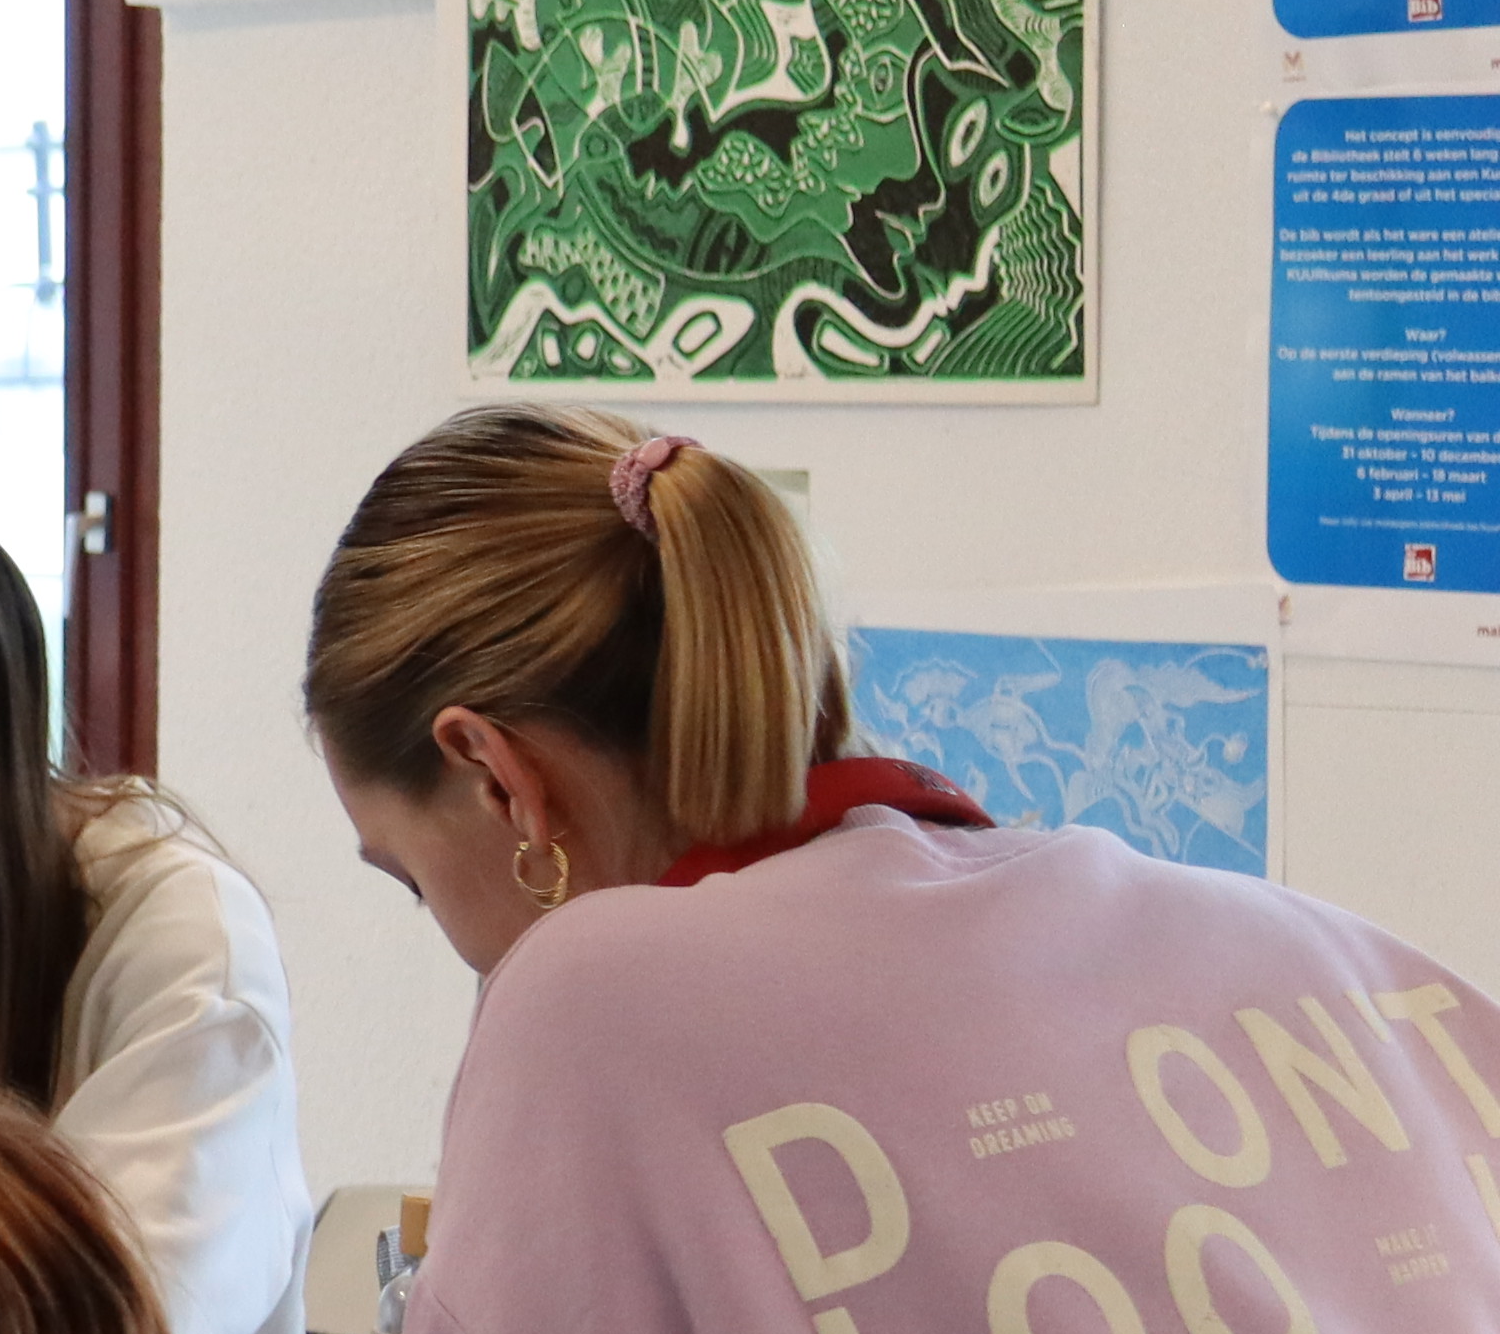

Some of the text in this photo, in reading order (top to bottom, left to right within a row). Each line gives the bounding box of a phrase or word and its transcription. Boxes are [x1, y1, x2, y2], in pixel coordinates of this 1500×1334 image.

[1405, 328, 1447, 342] Waar?
[1358, 447, 1407, 461] oktober
[1384, 486, 1414, 503] april
[966, 1092, 1054, 1129] KEEP ON
[968, 1116, 1077, 1160] DREAMING
